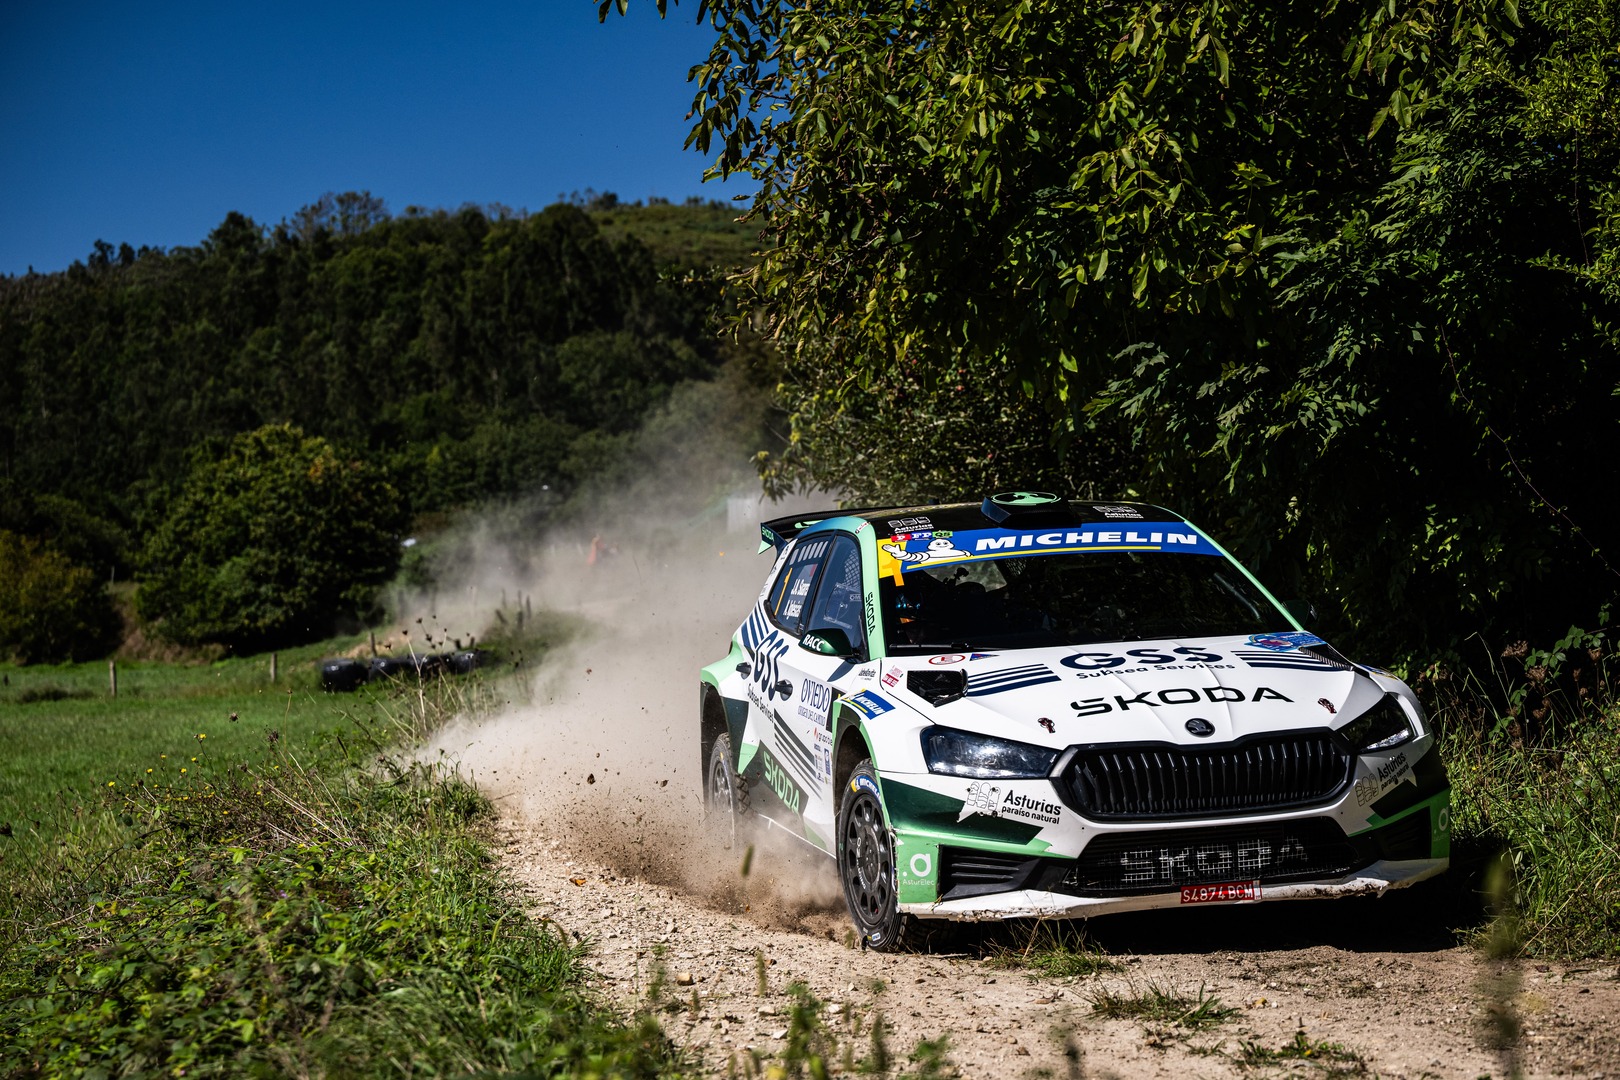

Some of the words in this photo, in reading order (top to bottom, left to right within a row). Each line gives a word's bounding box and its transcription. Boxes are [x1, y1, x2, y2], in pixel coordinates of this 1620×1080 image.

[975, 531, 1198, 552] MICHELIN
[881, 557, 905, 587] 1
[865, 591, 877, 637] SKODA
[802, 633, 825, 652] RACC
[754, 629, 790, 702] GSS
[1059, 646, 1224, 670] GSS
[1075, 665, 1149, 680] Subsea
[1153, 661, 1237, 672] Services
[800, 679, 831, 713] OVIEDO
[855, 694, 886, 715] MICHELIN
[1070, 685, 1295, 718] SKODA
[1376, 751, 1408, 782] Asturias
[763, 750, 801, 814] SKODA
[1001, 805, 1031, 819] paraíso
[1030, 812, 1060, 825] natural
[1003, 789, 1062, 816] Asturias
[1120, 836, 1309, 883] SKODA
[902, 878, 935, 887] AsturElec
[1182, 885, 1226, 903] S4874
[1227, 884, 1254, 900] BCM
